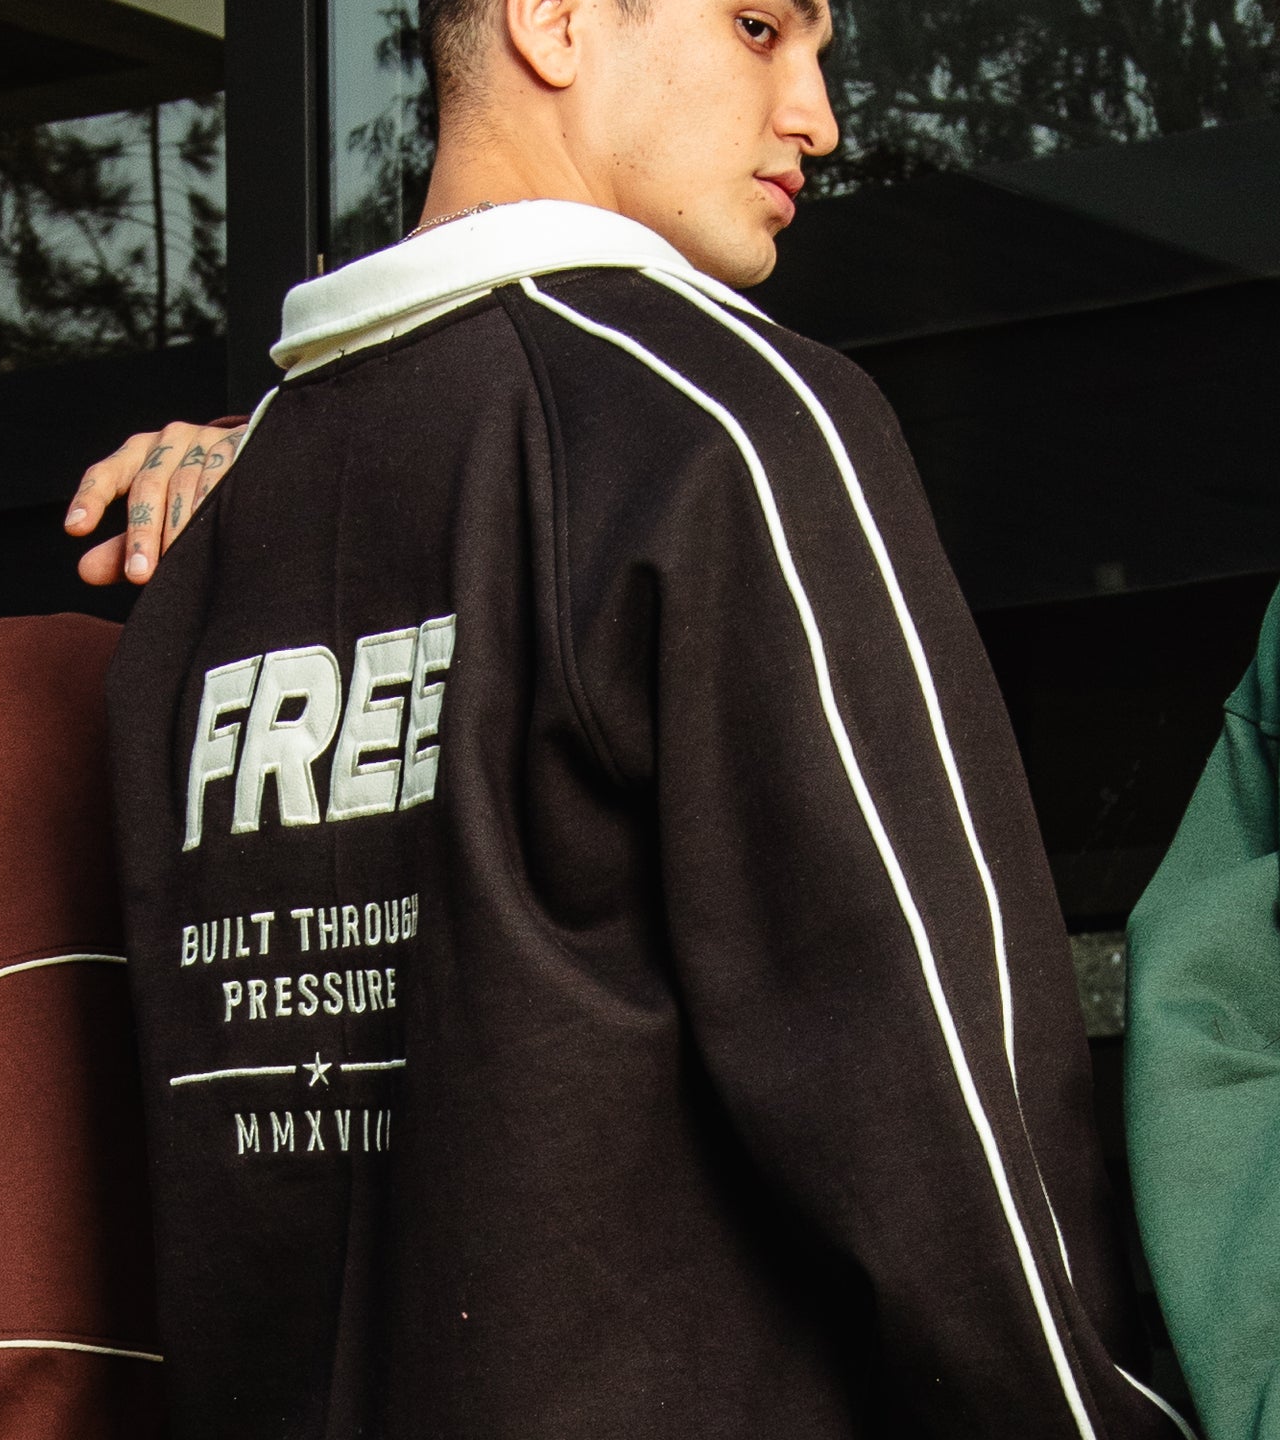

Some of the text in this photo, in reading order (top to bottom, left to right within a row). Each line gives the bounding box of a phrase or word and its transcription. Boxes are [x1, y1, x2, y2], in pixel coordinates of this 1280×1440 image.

[182, 613, 457, 852] FREE
[180, 893, 418, 968] BUILT THROUGH
[223, 967, 397, 1023] PRESSURE
[234, 1109, 391, 1155] MMXVIII
